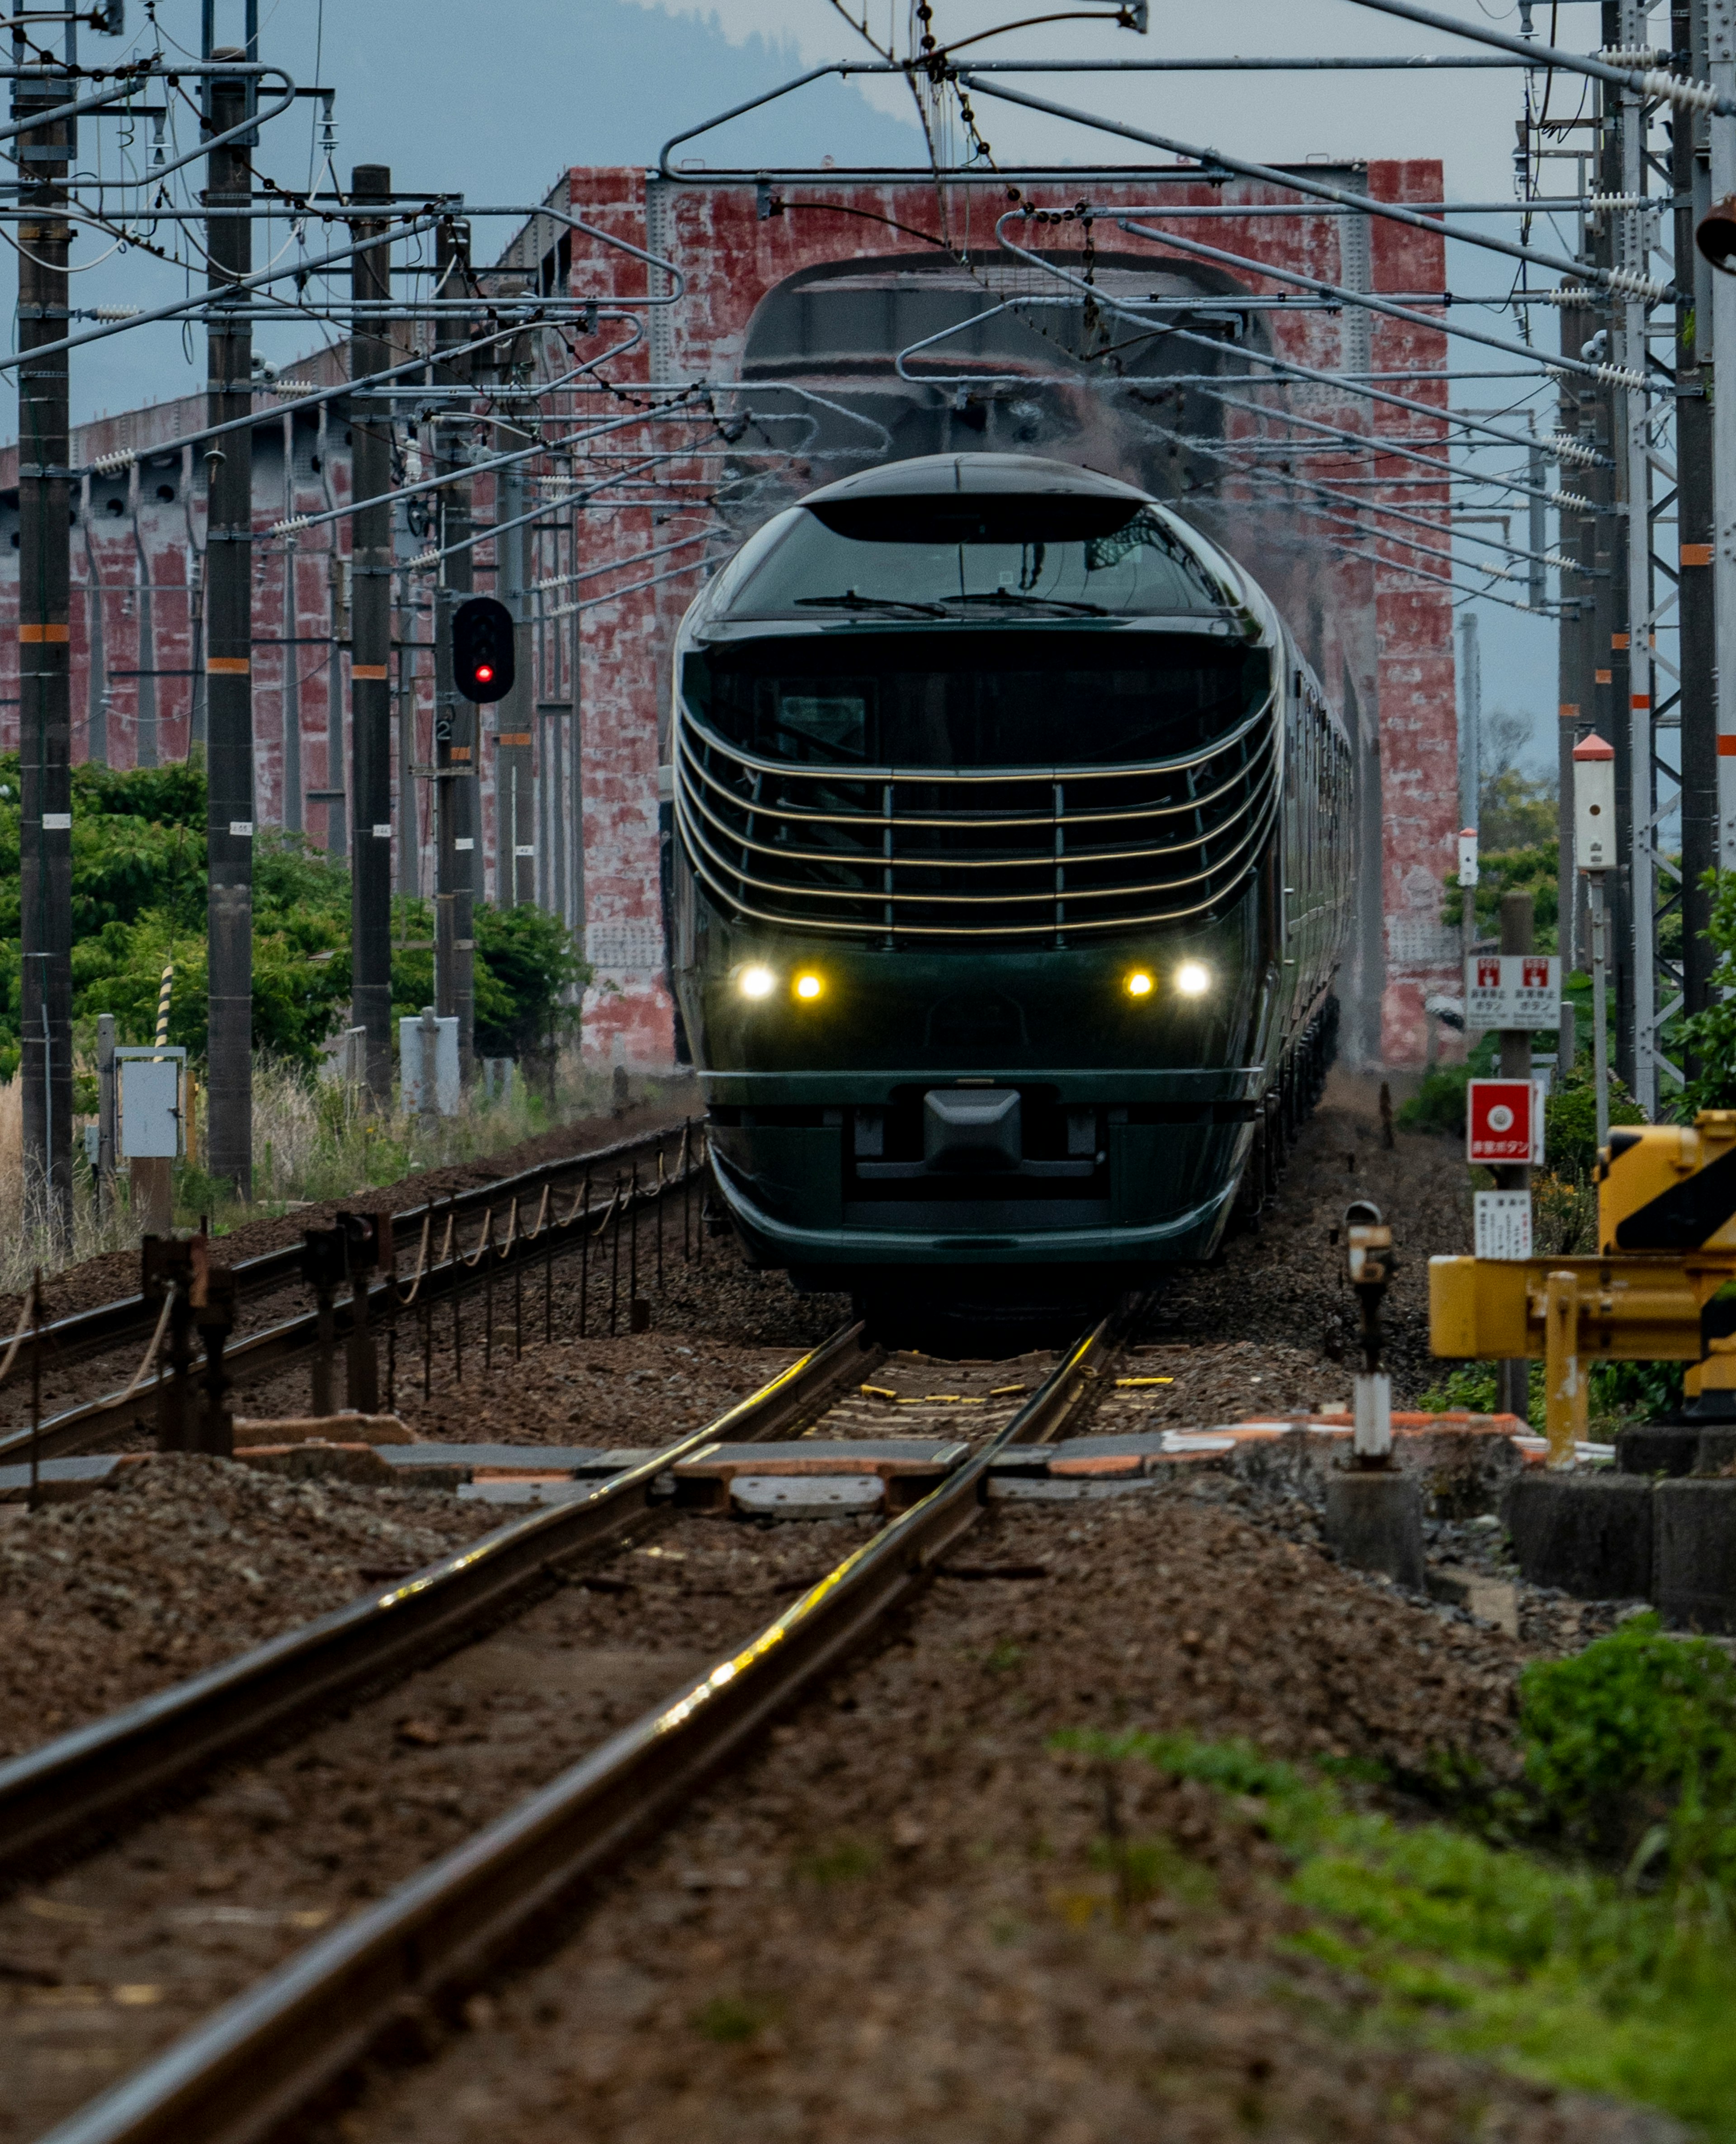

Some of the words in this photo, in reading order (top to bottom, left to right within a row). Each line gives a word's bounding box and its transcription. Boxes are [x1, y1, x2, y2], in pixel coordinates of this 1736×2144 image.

[437, 721, 451, 740] 2
[1472, 1140, 1528, 1155] 非常ボタン
